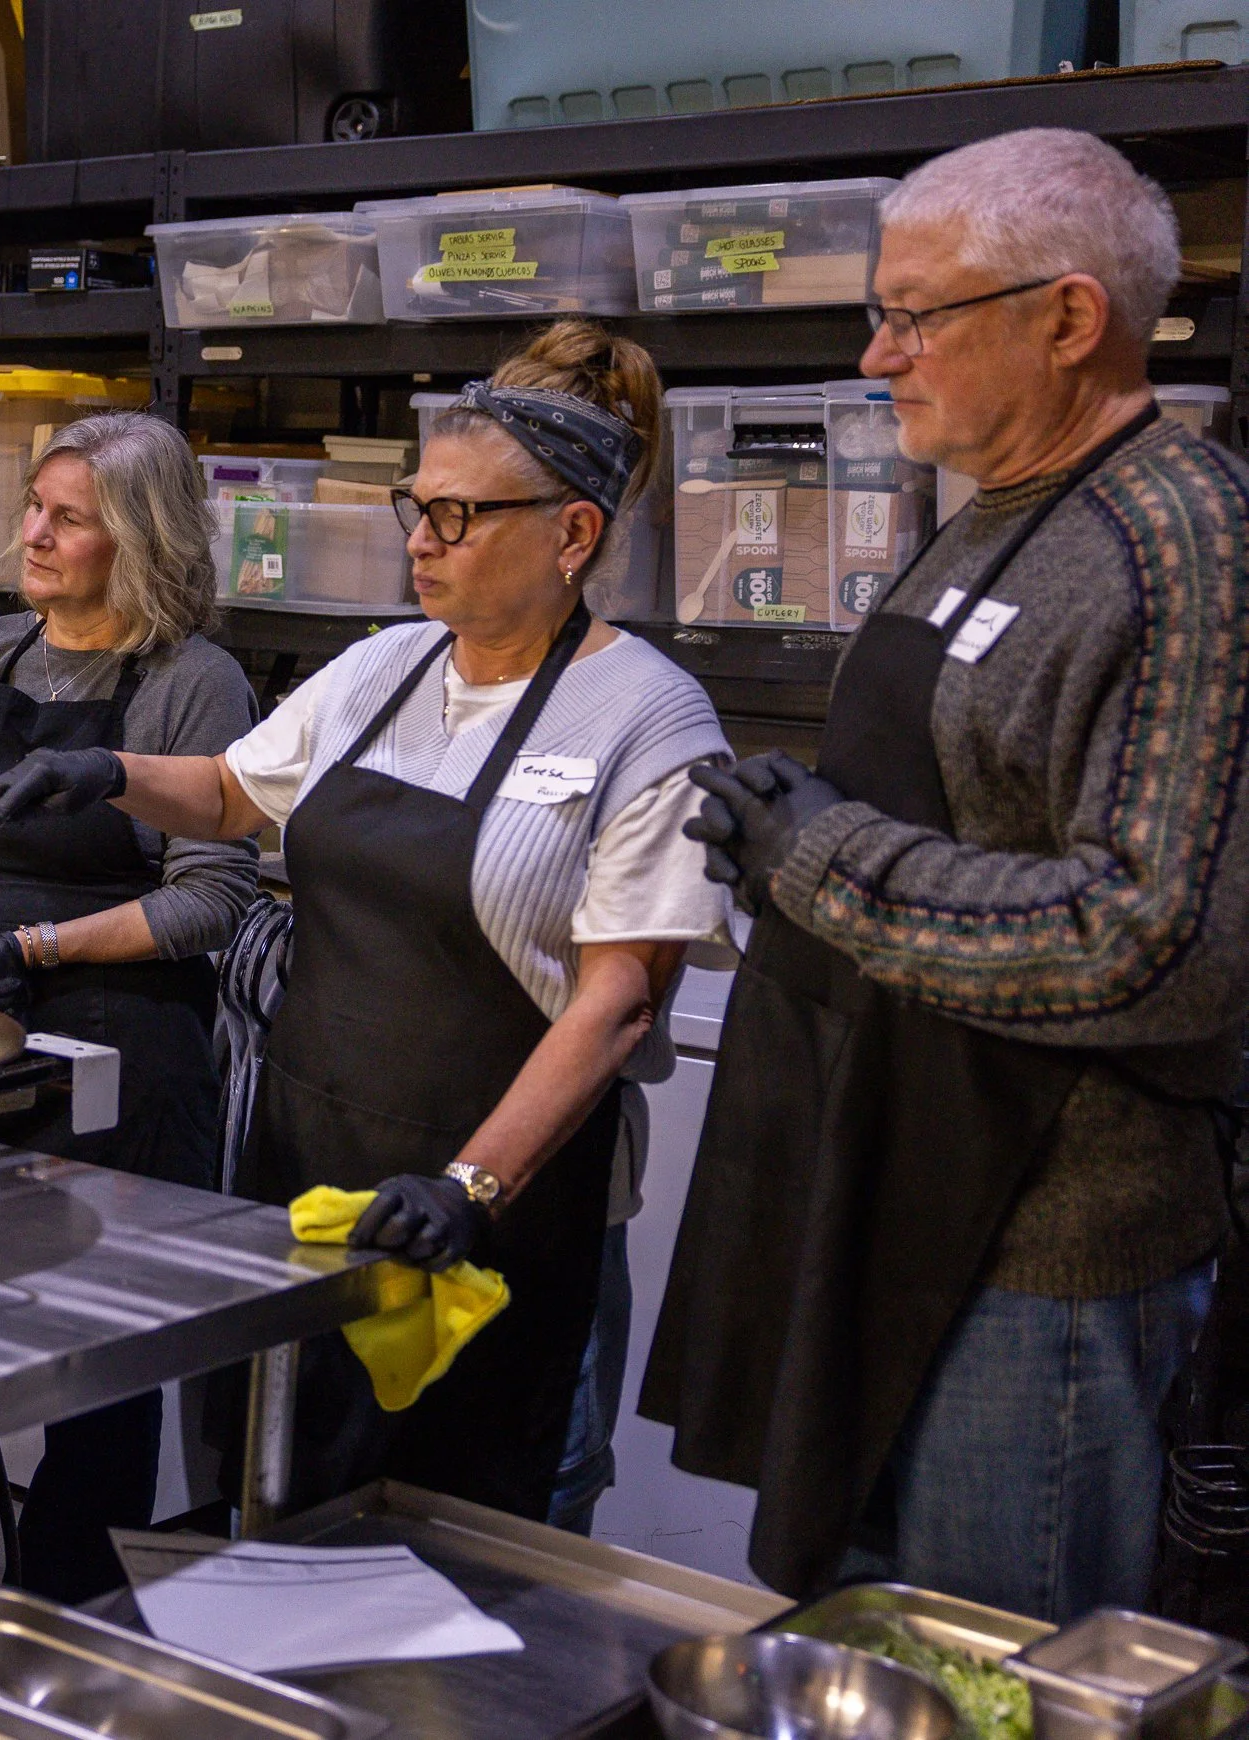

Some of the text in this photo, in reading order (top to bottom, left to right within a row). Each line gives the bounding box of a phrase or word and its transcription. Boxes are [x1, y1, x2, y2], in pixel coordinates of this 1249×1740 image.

[715, 236, 776, 252] SHOT GLASSES
[447, 250, 507, 262] PINZAS SERVIR
[733, 258, 767, 270] SPOONS
[429, 267, 455, 278] OLIVES
[233, 304, 273, 314] NAPKINS
[736, 546, 778, 555] SPOON
[845, 548, 888, 560] SPOON
[750, 570, 767, 607] 100
[854, 574, 873, 613] 100
[757, 609, 799, 618] CUTLERY
